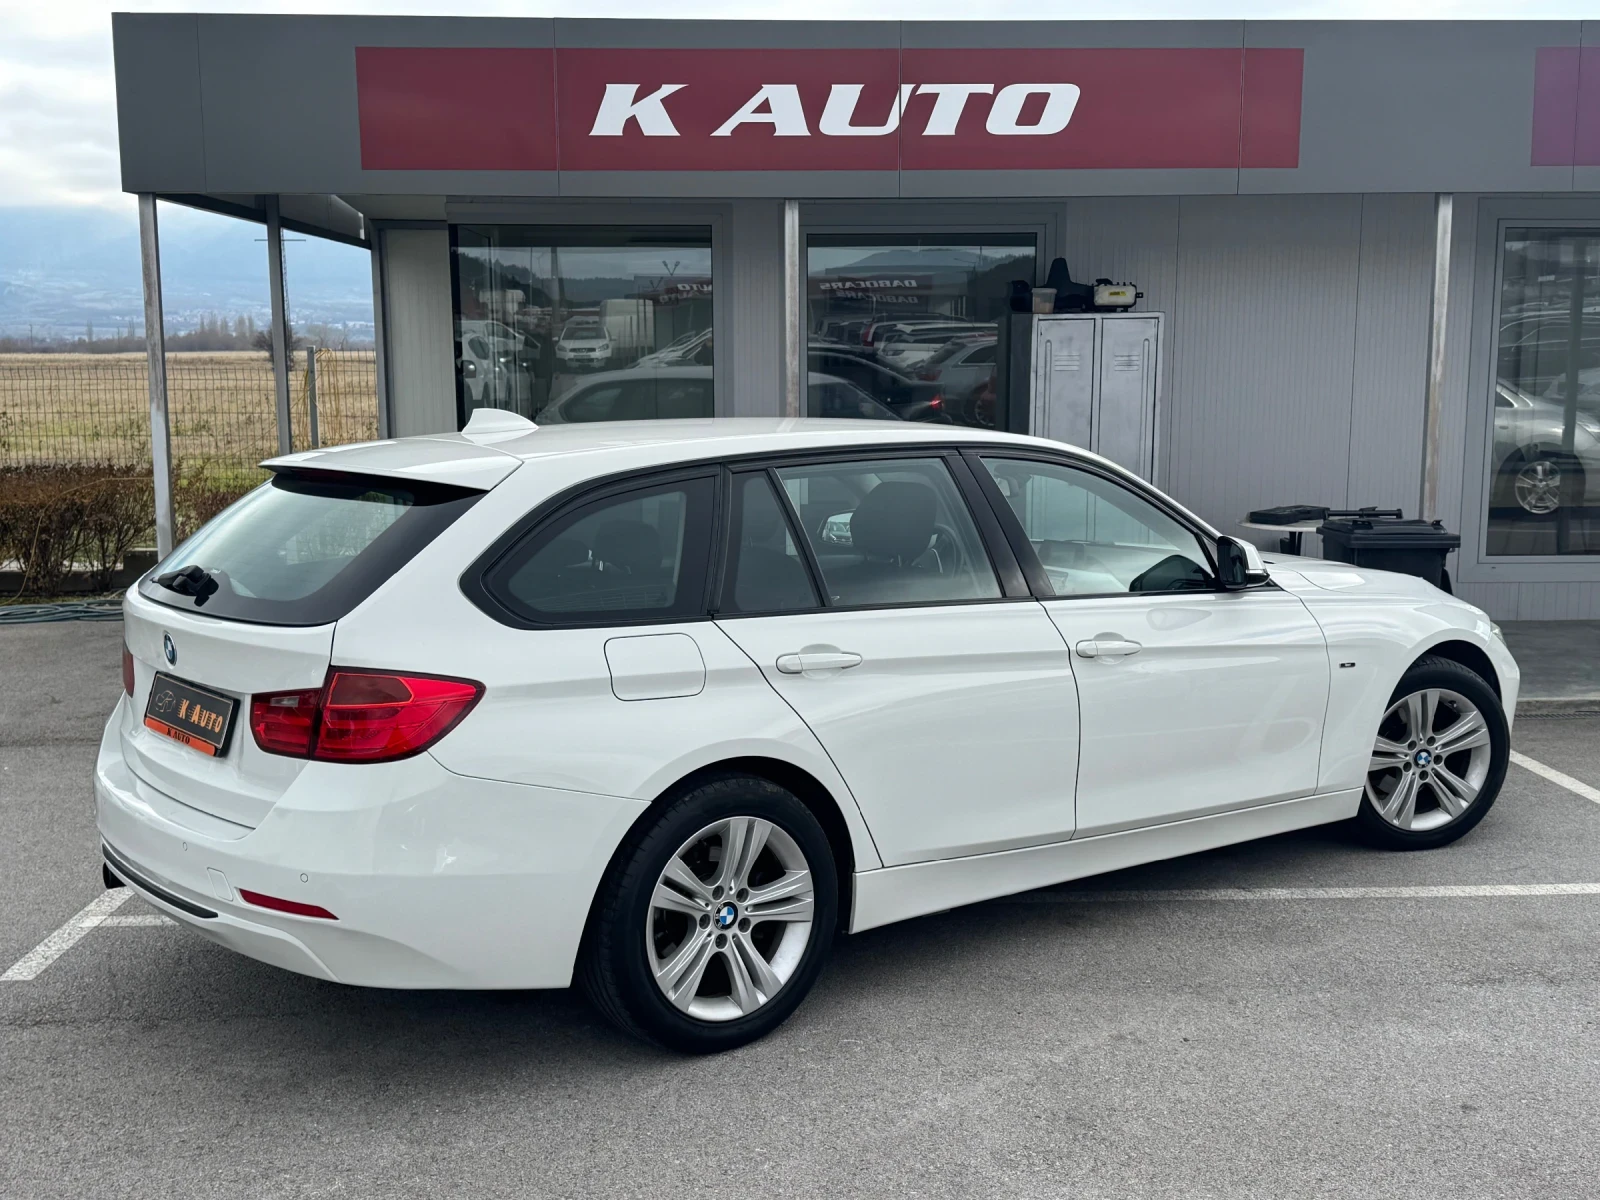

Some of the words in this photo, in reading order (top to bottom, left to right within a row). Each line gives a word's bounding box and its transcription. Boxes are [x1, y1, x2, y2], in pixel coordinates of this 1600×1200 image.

[588, 83, 690, 137] K
[709, 83, 1081, 137] AUTO
[178, 699, 190, 719] K
[190, 704, 223, 733] AUTO
[166, 727, 172, 737] K
[173, 730, 190, 744] AUTO
